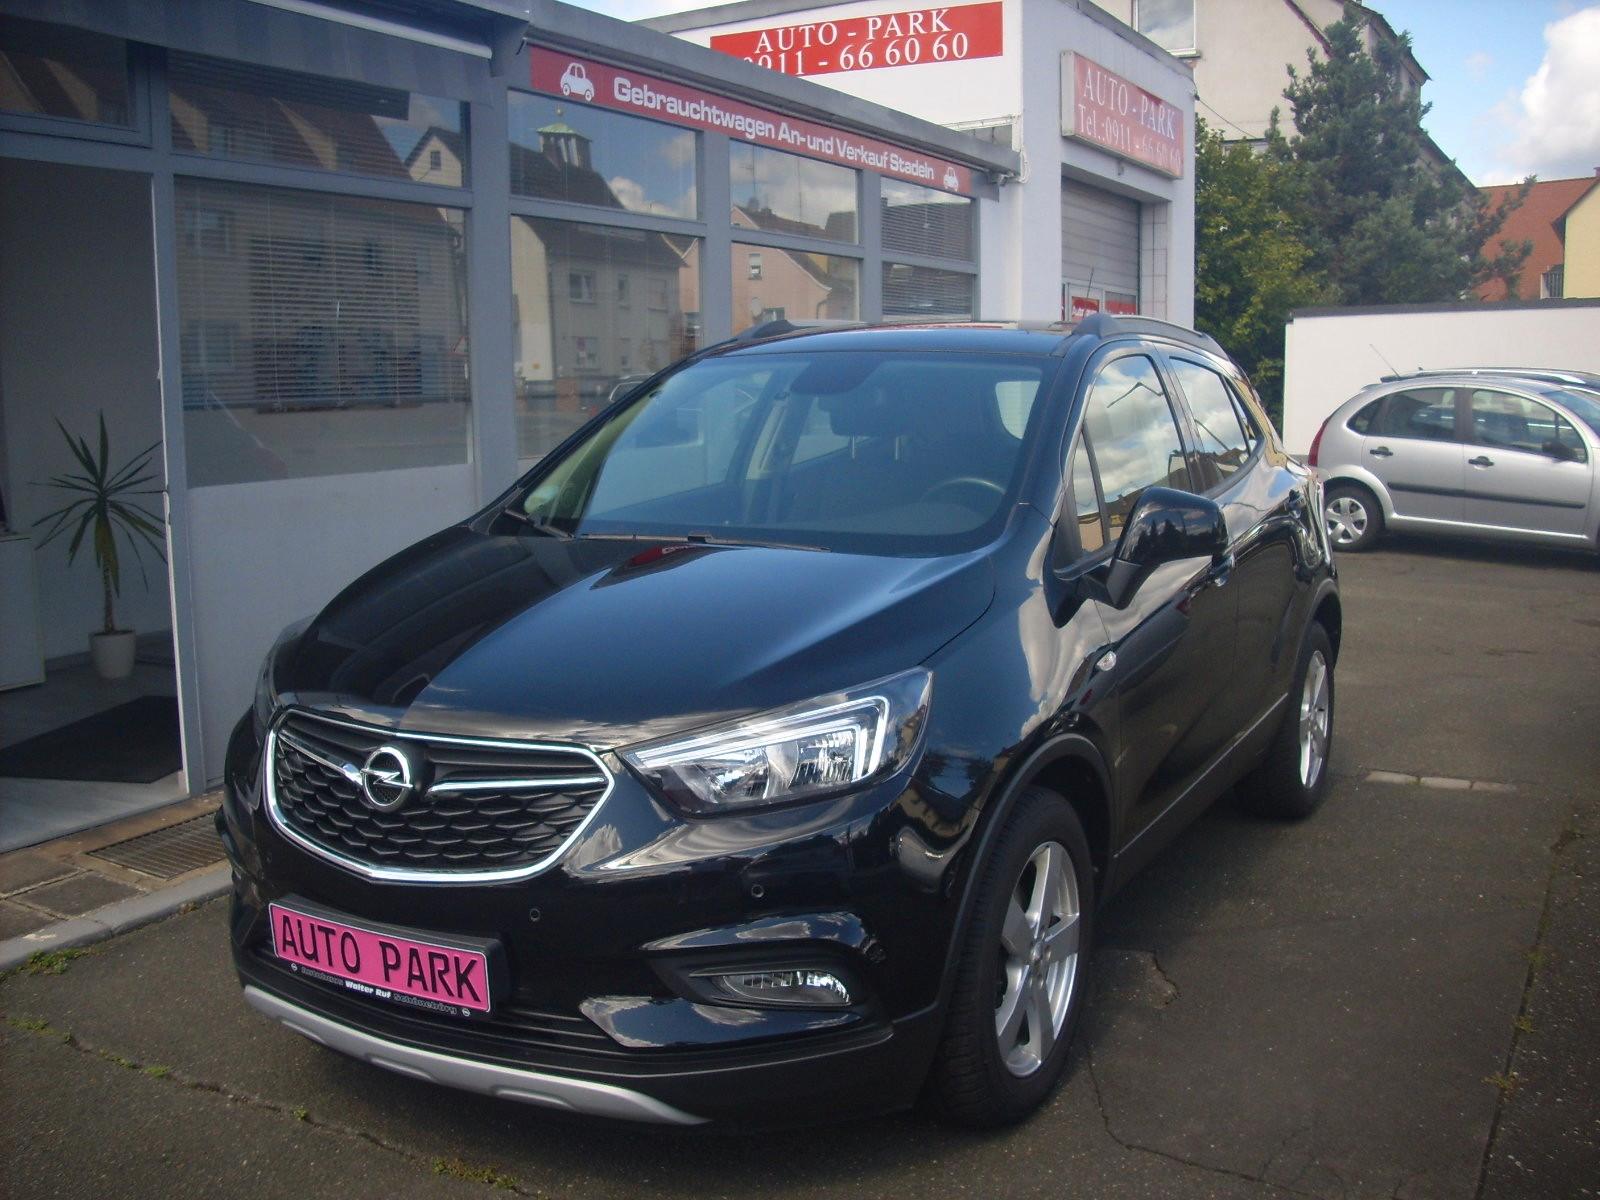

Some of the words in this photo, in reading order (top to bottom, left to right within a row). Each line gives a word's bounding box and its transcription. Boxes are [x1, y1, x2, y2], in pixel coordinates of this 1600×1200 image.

[755, 22, 838, 54] AUTO
[867, 8, 952, 40] PARK
[839, 42, 873, 70] 66
[885, 37, 920, 65] 60
[932, 32, 968, 60] 60
[613, 76, 775, 139] Gebrauchtwagen
[836, 138, 888, 168] Verkauf
[889, 153, 934, 180] Stadeln
[1083, 67, 1128, 116] AUTO
[1140, 94, 1175, 140] PARK
[282, 914, 361, 974] AUTO
[379, 940, 482, 1003] PARK
[345, 980, 375, 996] Walter
[375, 989, 392, 999] Ruf
